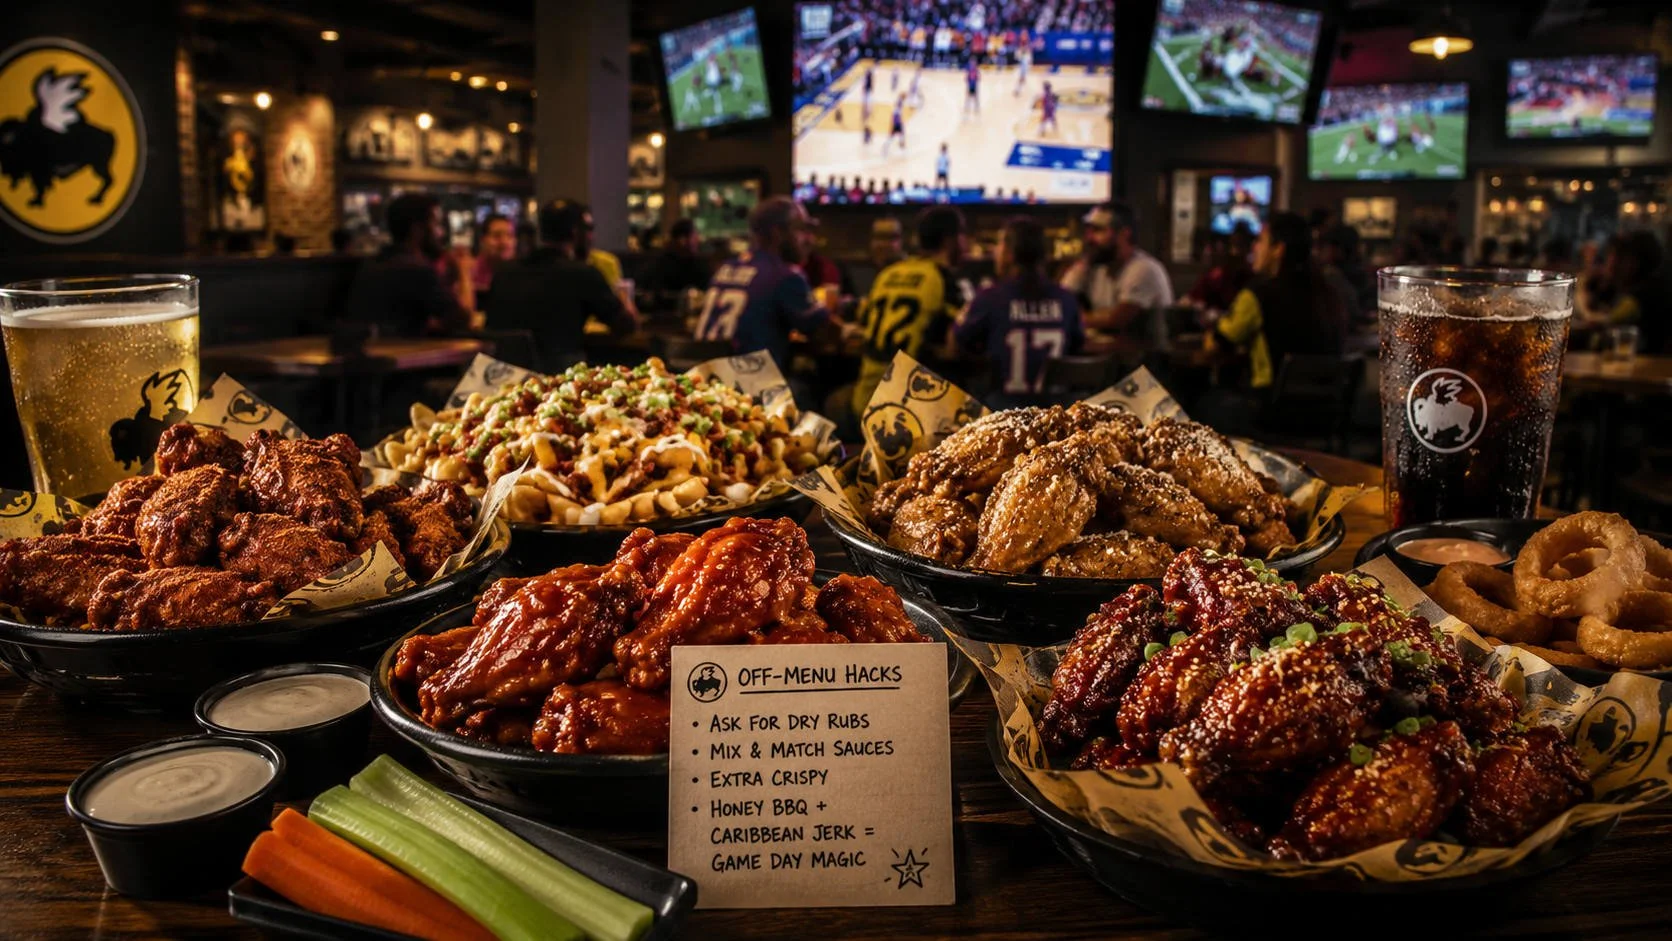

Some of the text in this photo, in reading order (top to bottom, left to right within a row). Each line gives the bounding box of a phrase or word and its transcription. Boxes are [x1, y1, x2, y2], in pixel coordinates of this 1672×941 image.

[1004, 329, 1065, 393] 17
[738, 664, 902, 686] OFF-MENU HACKS
[710, 713, 869, 732] ASK FOR DRY RUBS
[711, 740, 894, 760] MIX & MATCH SAUCES
[711, 769, 828, 788] EXTRA CRISPY
[711, 799, 827, 818] HONEY BBQ +
[711, 827, 803, 844] CARIBBEAN
[813, 824, 856, 841] JERK
[712, 851, 866, 873] GAME DAY MAGIC
